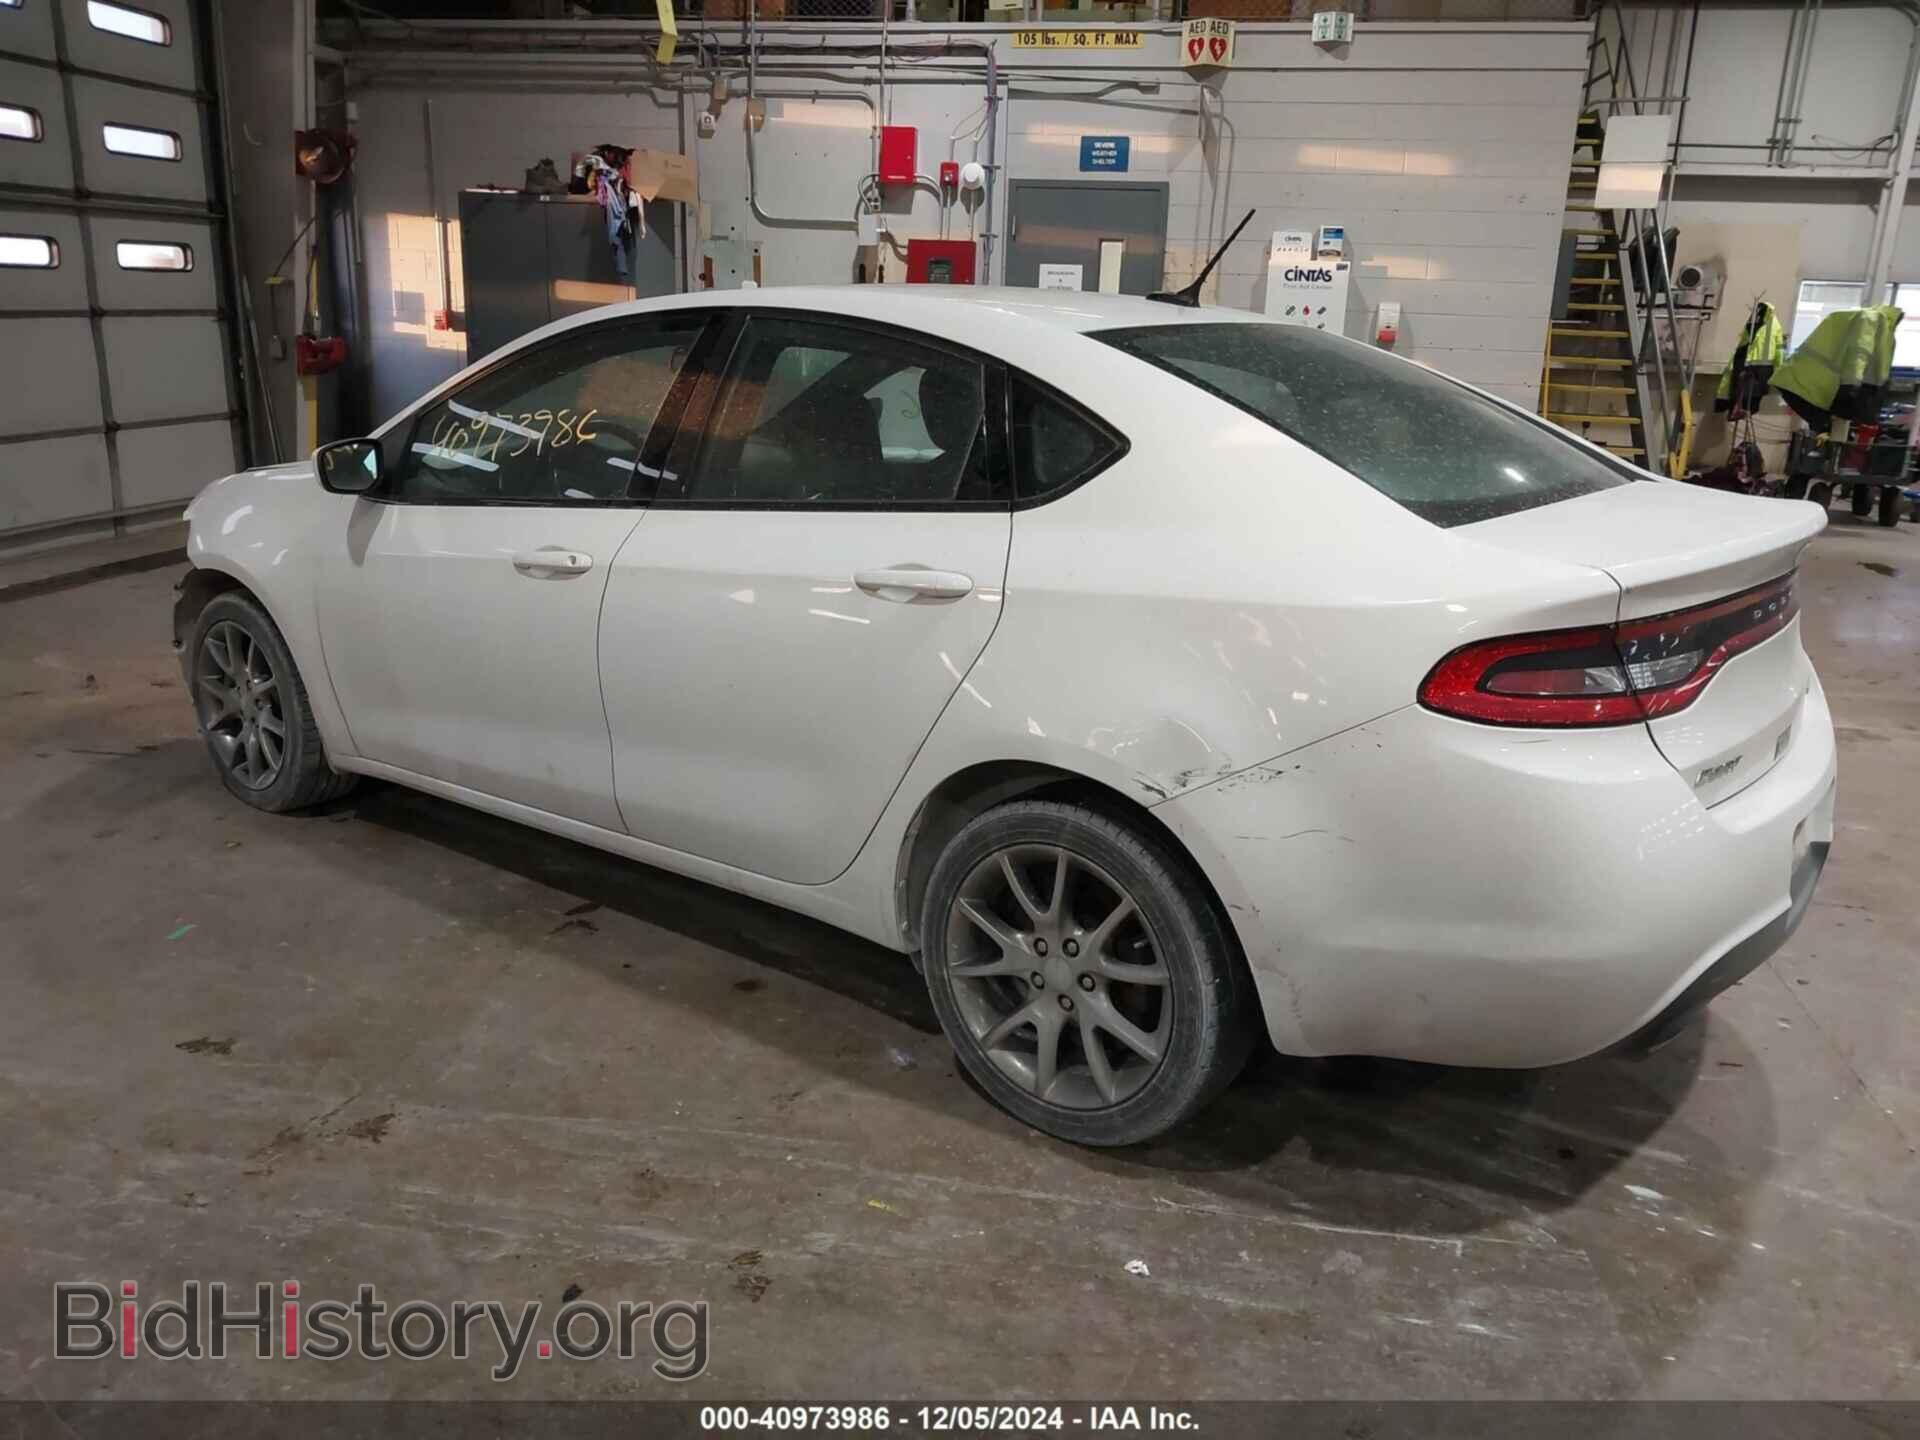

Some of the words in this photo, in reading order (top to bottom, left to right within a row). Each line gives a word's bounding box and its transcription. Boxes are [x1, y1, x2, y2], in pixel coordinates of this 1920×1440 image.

[1189, 21, 1206, 34] AED
[1210, 21, 1229, 34] AED
[1018, 33, 1037, 45] 105
[1041, 33, 1060, 45] lbs.
[1064, 33, 1069, 44] /
[1073, 33, 1090, 45] SQ.
[1095, 33, 1110, 45] FT.
[1114, 33, 1139, 45] MAX
